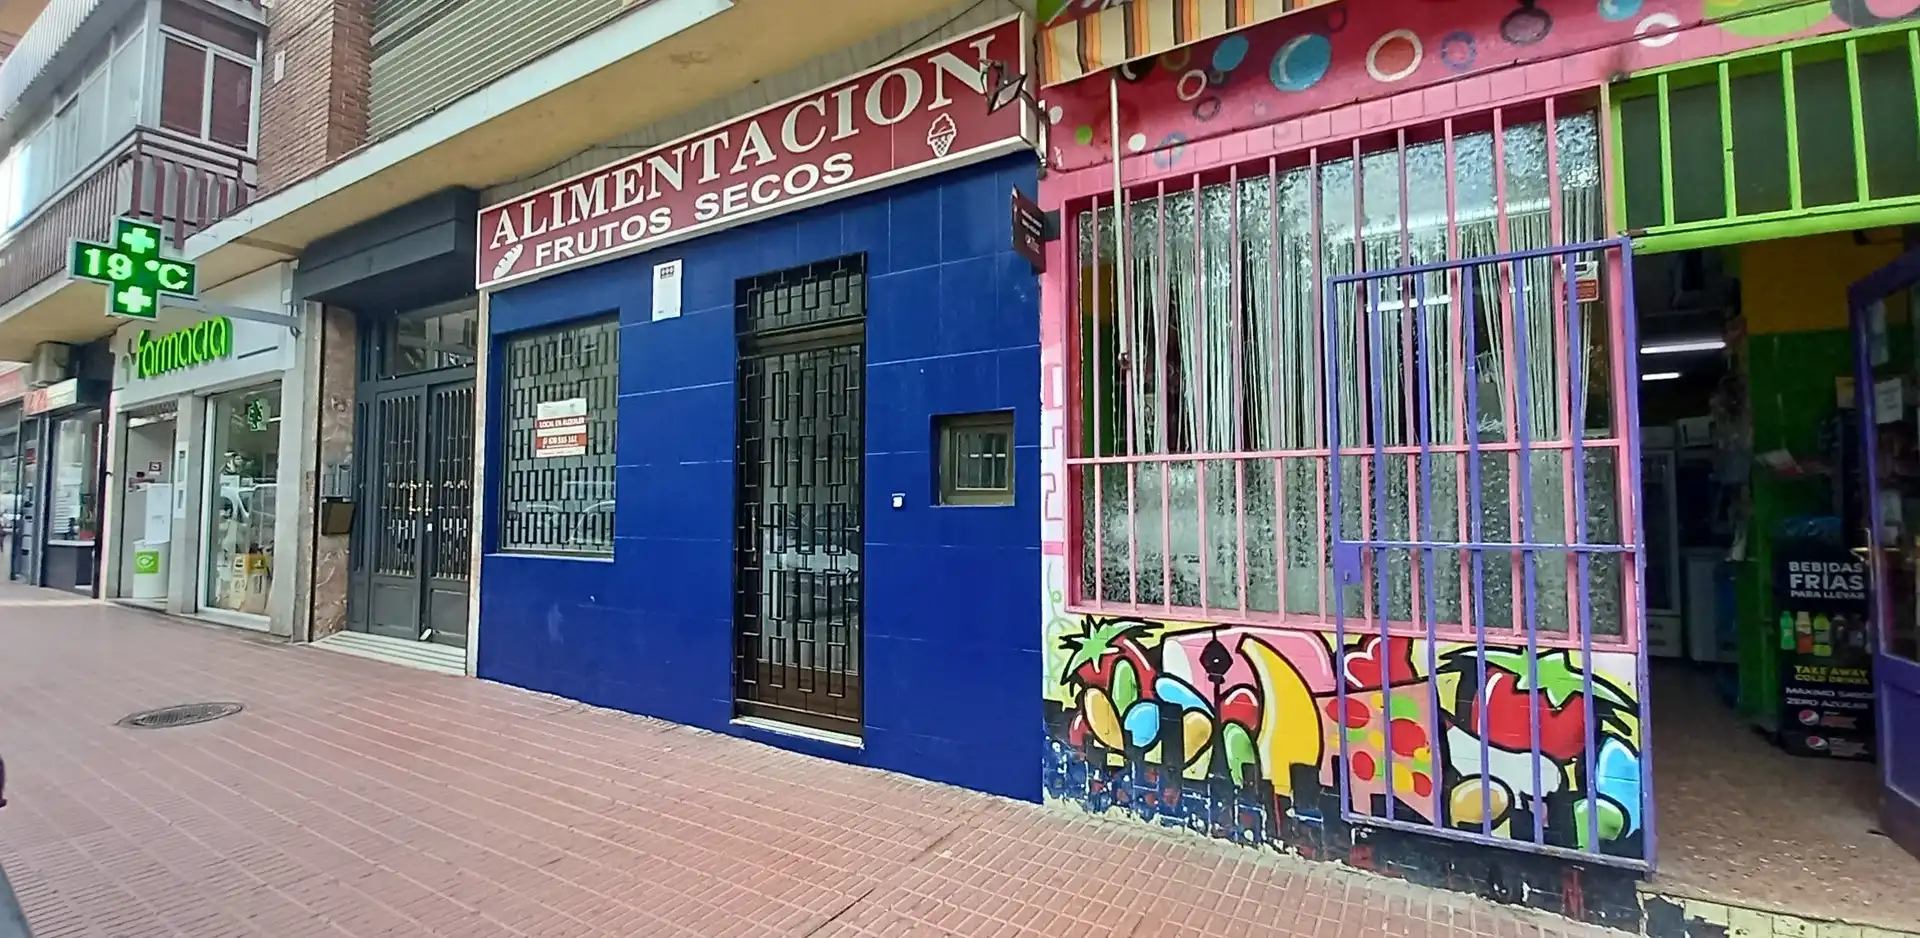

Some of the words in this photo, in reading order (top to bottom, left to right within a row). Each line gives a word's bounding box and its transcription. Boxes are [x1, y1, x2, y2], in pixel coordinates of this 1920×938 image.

[489, 34, 996, 250] ALIMENTACION
[535, 206, 672, 267] FRUTOS
[693, 152, 854, 221] SECOS
[84, 248, 133, 280] 19
[138, 316, 232, 379] farmacia
[1788, 561, 1864, 573] BEBIDAS
[1790, 590, 1821, 598] PARA
[1823, 591, 1865, 599] LLEVAR
[1794, 665, 1827, 675] TAKE
[1830, 667, 1867, 677] AWAY
